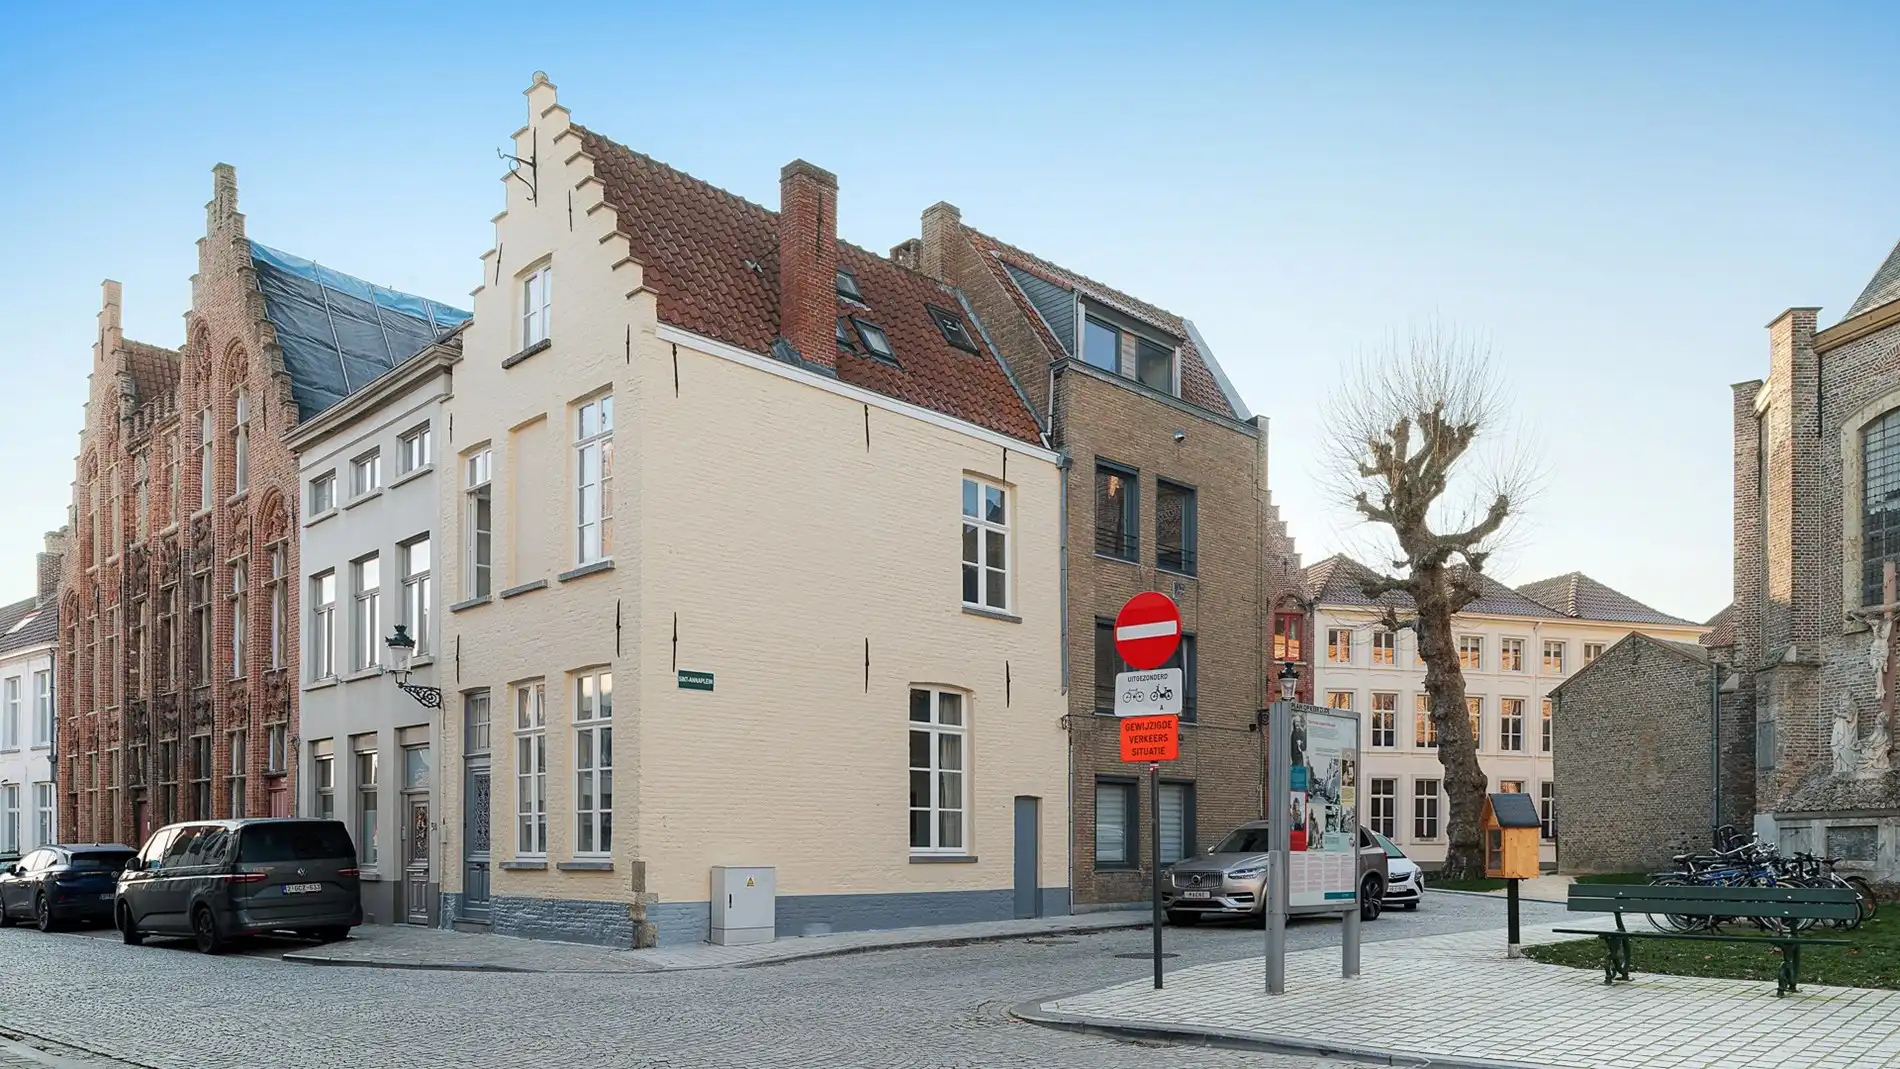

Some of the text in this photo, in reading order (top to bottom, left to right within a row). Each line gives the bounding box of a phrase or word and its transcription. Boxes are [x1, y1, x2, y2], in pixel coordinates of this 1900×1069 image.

[679, 676, 713, 685] SINT-ANNAPLEIN
[1127, 673, 1168, 682] UITGEZONDERD
[1125, 720, 1172, 732] GEWIJZIGDE
[1128, 733, 1169, 744] VERKEERS
[1131, 746, 1165, 757] SITUATIE
